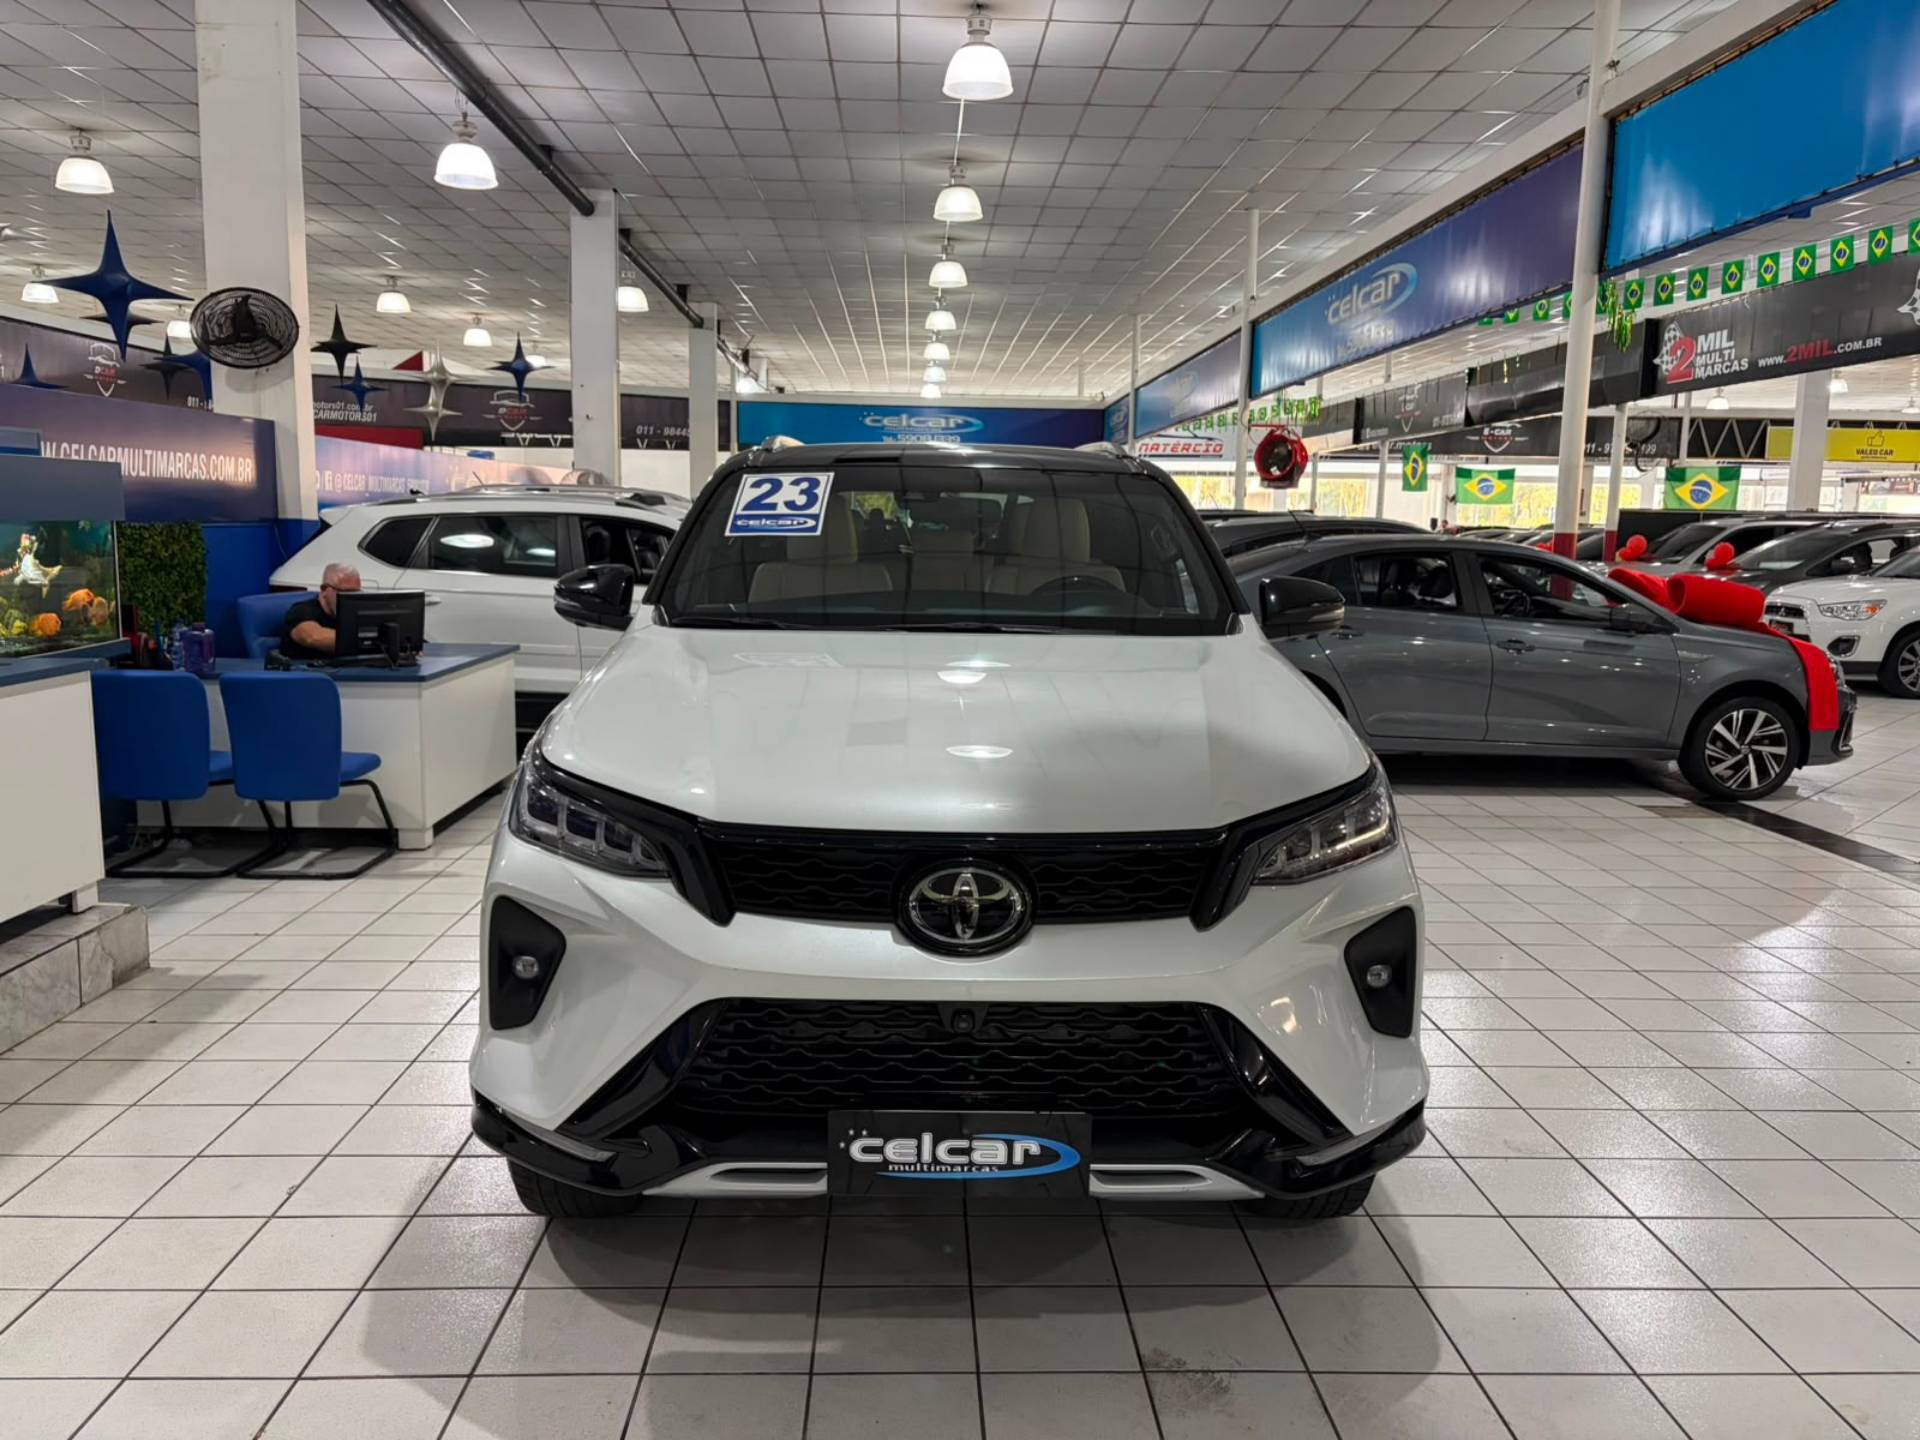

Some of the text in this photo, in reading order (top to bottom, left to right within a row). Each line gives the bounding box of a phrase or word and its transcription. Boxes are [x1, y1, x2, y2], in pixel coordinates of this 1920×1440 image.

[1327, 271, 1401, 325] celcar
[1697, 328, 1735, 353] MIL
[1667, 335, 1697, 384] 2
[1694, 357, 1749, 381] MARCAS
[1695, 348, 1736, 367] MULTI
[635, 424, 654, 435] 011
[863, 413, 963, 428] celcar
[1139, 440, 1224, 454] NATÉRCIO
[40, 441, 253, 482] WCELCARMULTIMARCAS.COM.BR
[742, 477, 821, 511] 23
[849, 1132, 1041, 1165] celcar
[888, 1163, 999, 1173] multimarcas
